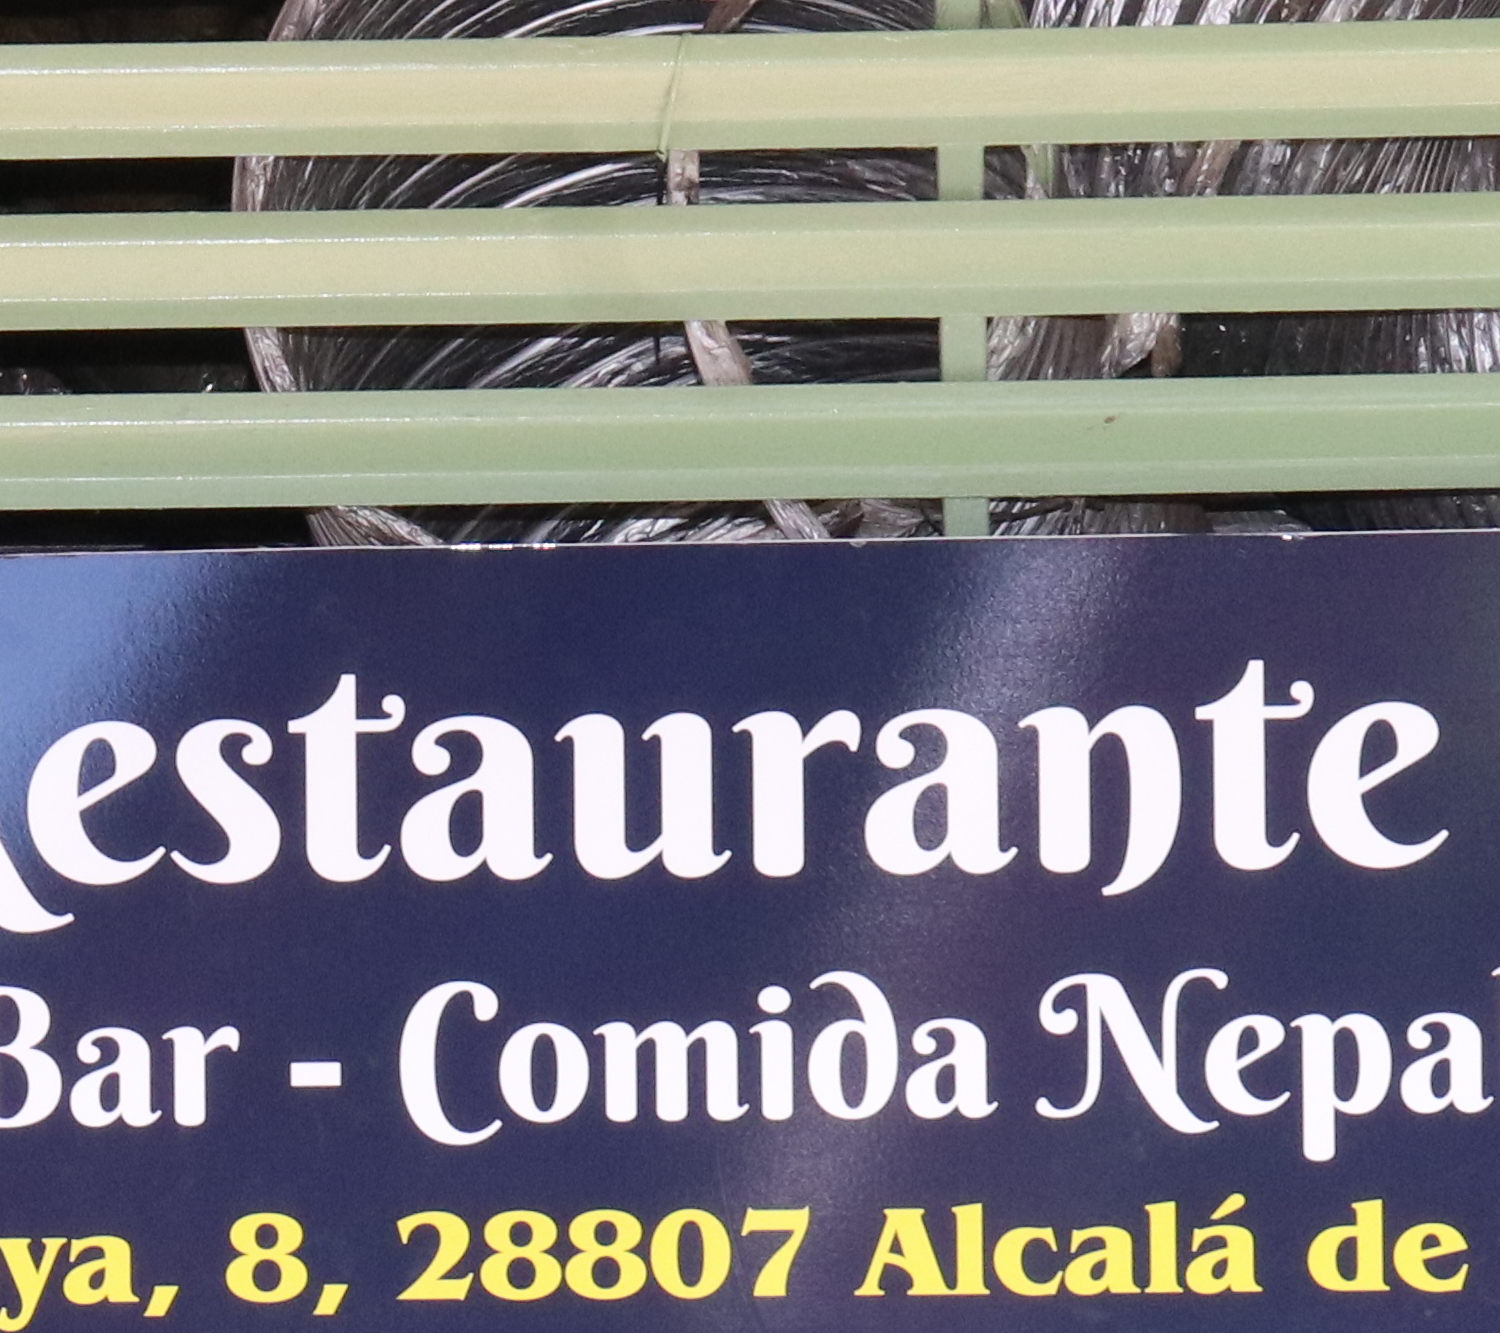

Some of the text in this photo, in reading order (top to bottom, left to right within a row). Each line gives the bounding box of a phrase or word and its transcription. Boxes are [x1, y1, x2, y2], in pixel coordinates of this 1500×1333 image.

[290, 1062, 341, 1087] -
[399, 971, 998, 1146] Comida
[225, 1212, 348, 1316] 8,
[397, 1206, 810, 1301] 28807
[854, 1193, 1263, 1297] Alcalá
[1307, 1199, 1469, 1293] de
